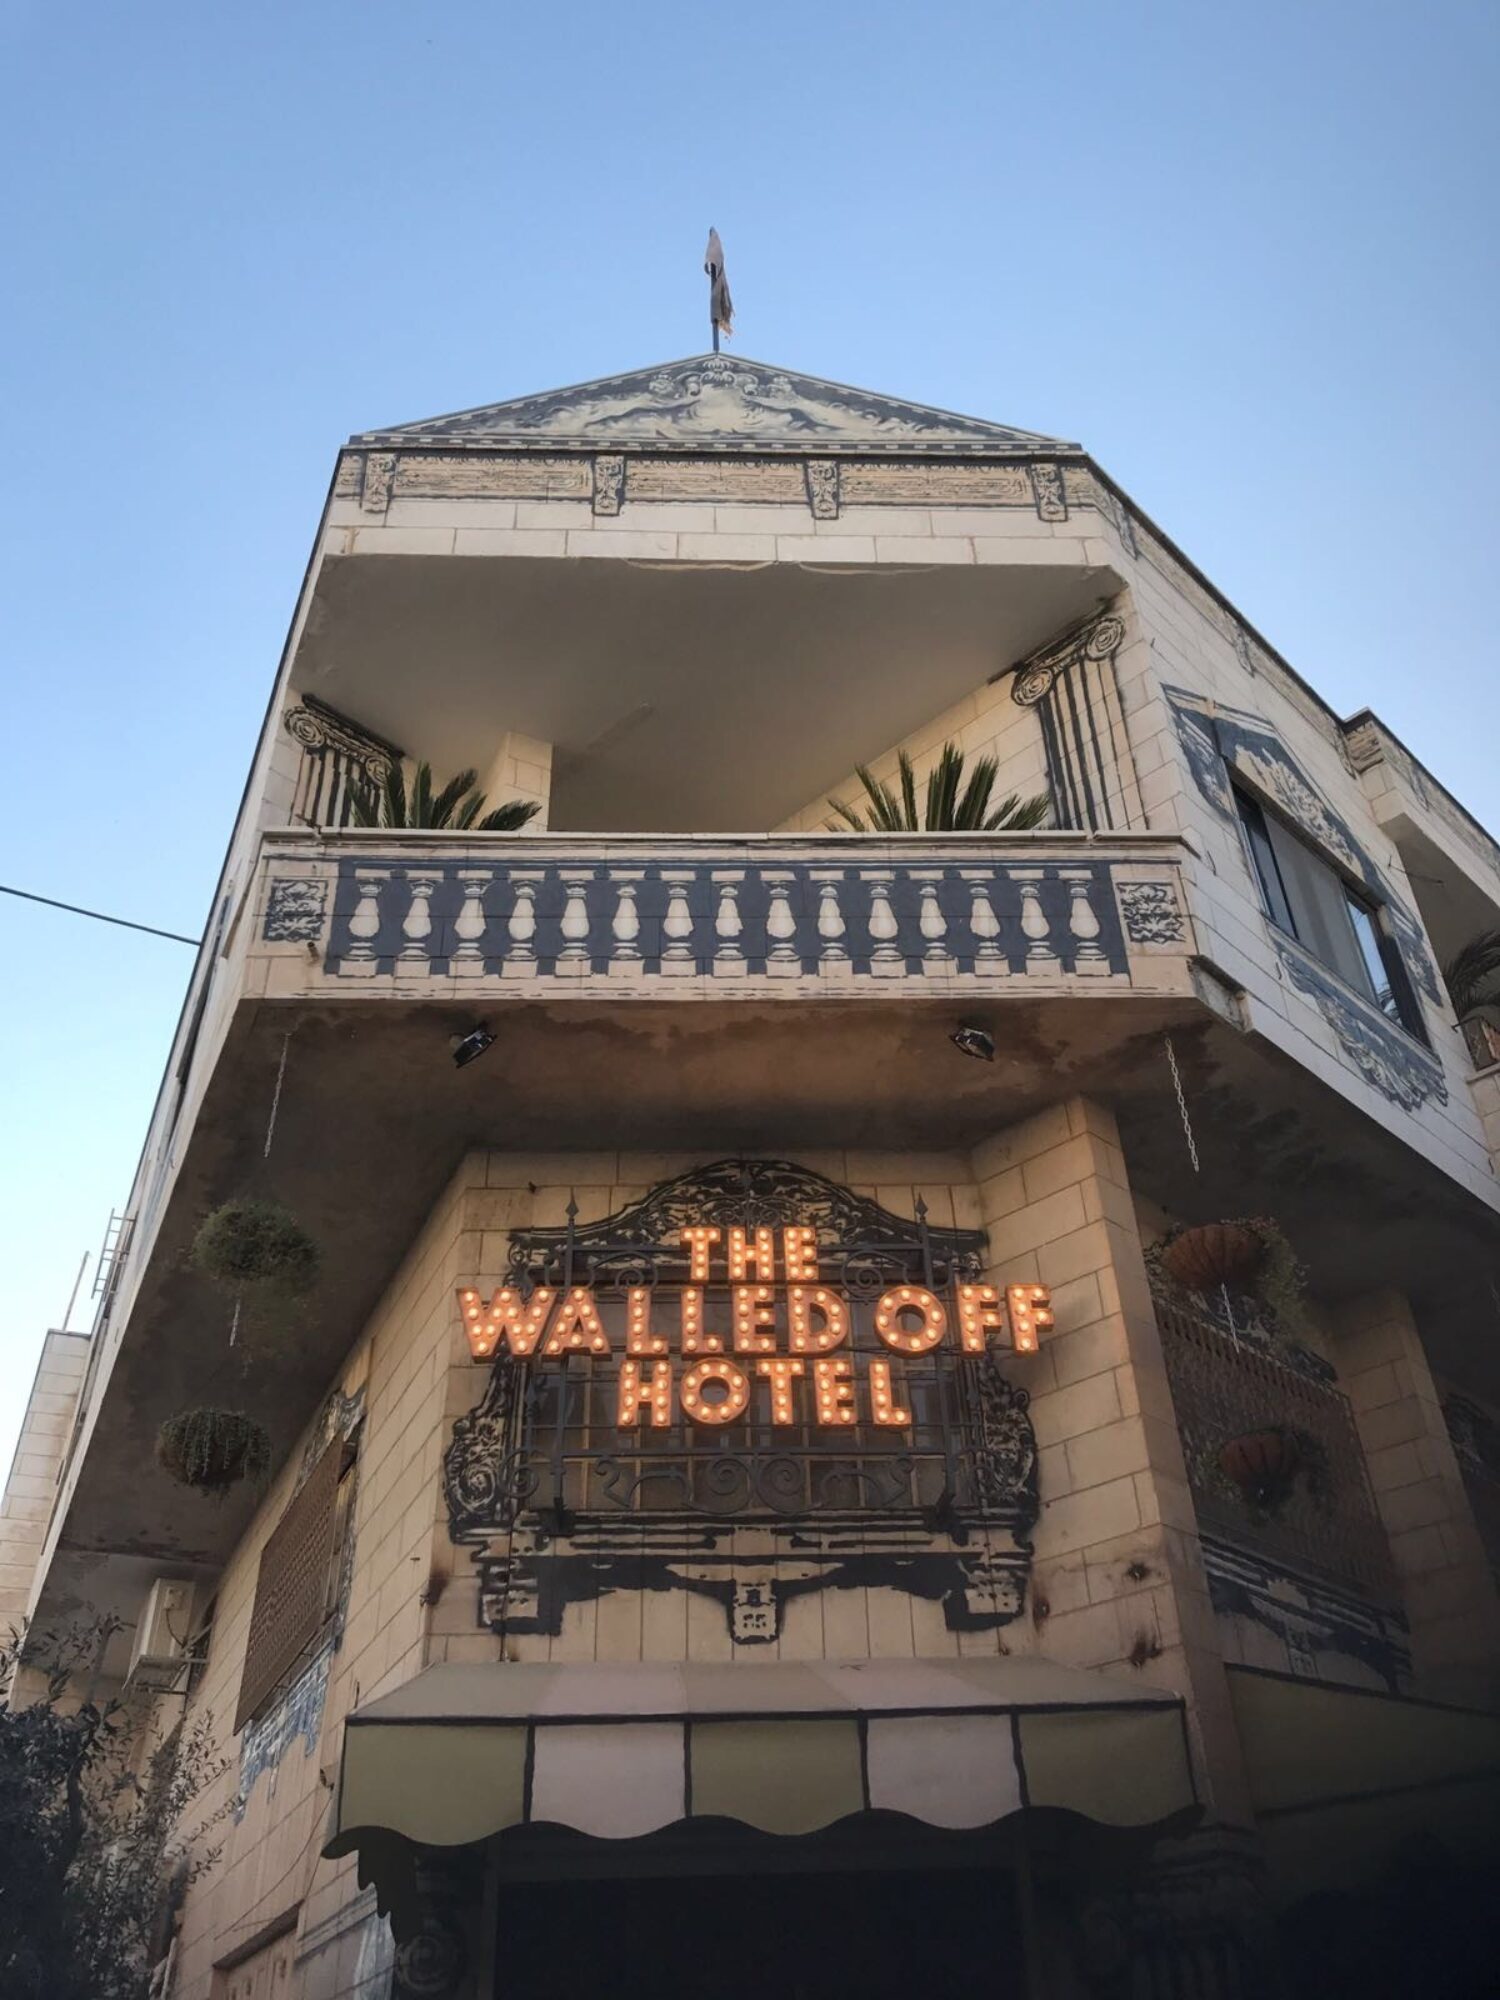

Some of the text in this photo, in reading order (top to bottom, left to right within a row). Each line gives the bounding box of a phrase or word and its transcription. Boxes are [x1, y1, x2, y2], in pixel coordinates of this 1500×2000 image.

[680, 1226, 819, 1281] THE
[456, 1284, 1054, 1362] WALLED OFF
[617, 1357, 911, 1428] HOTEL
